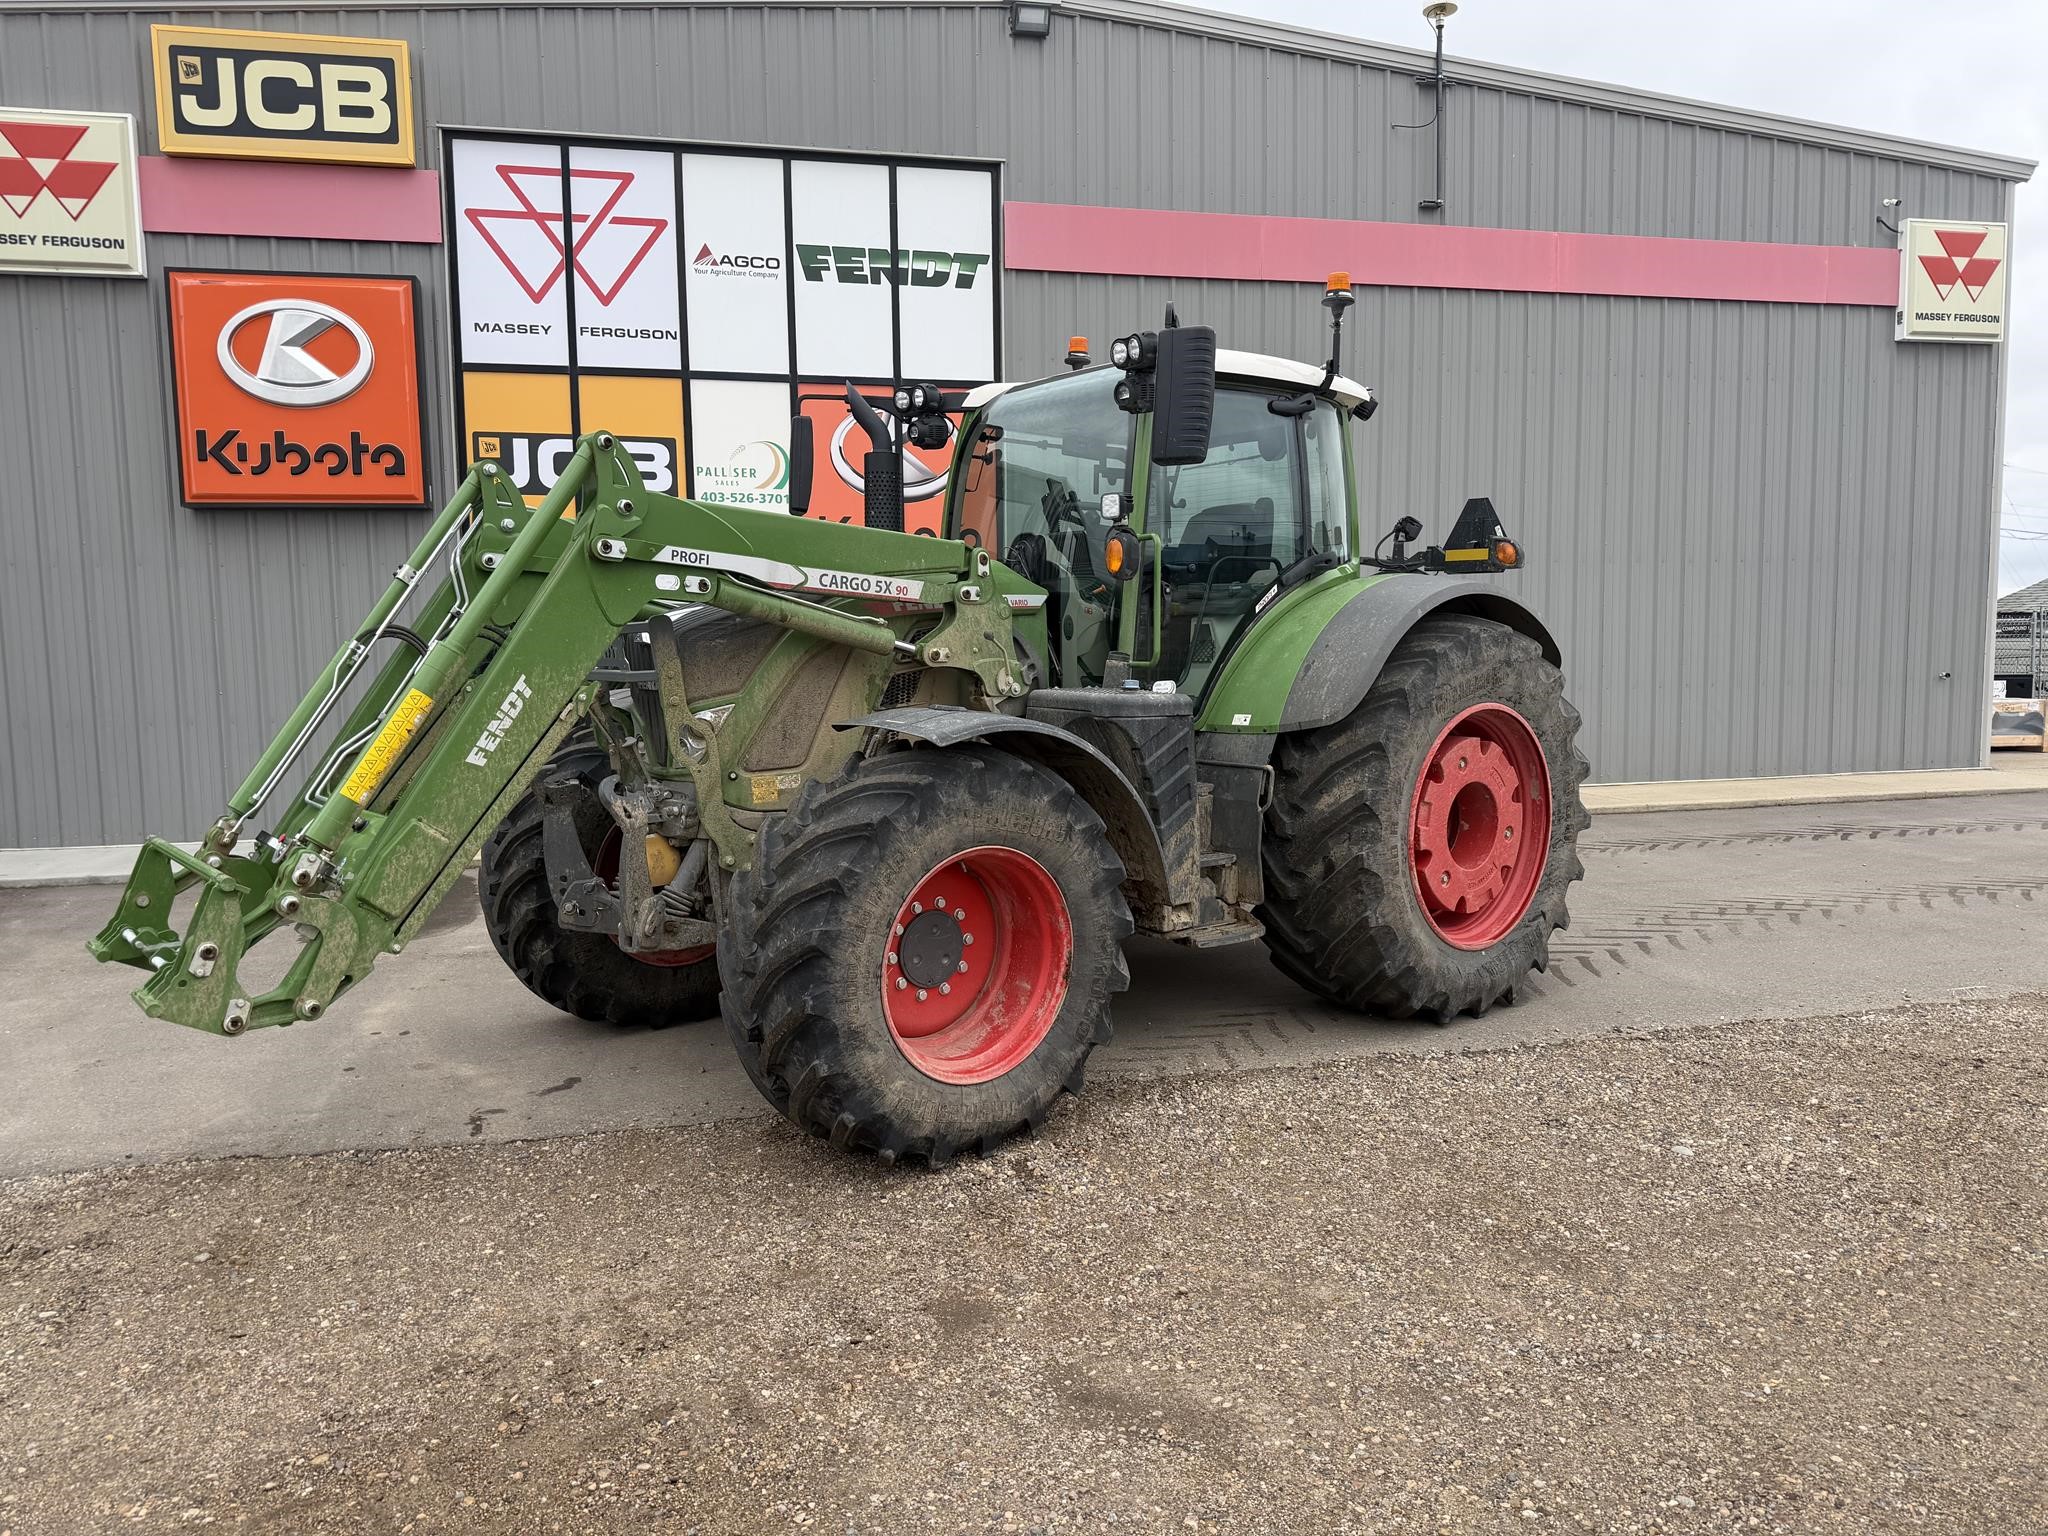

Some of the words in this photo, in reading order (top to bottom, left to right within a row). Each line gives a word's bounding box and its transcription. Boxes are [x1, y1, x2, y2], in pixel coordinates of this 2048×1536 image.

[180, 57, 391, 134] JCB
[42, 235, 125, 249] FERGUSON
[720, 255, 780, 270] AGCO
[795, 244, 990, 289] FENDT
[710, 268, 747, 277] Agriculture
[748, 270, 779, 280] Company
[1915, 312, 1952, 321] MASSEY
[1954, 314, 2000, 324] FERGUSON
[474, 322, 552, 335] MASSEY
[580, 327, 678, 340] FERGUSON
[195, 429, 405, 476] Kubota
[671, 549, 710, 566] PROFI
[819, 573, 871, 592] CARGO
[875, 579, 892, 595] 5X
[895, 586, 908, 596] 90
[465, 674, 532, 767] FENDT
